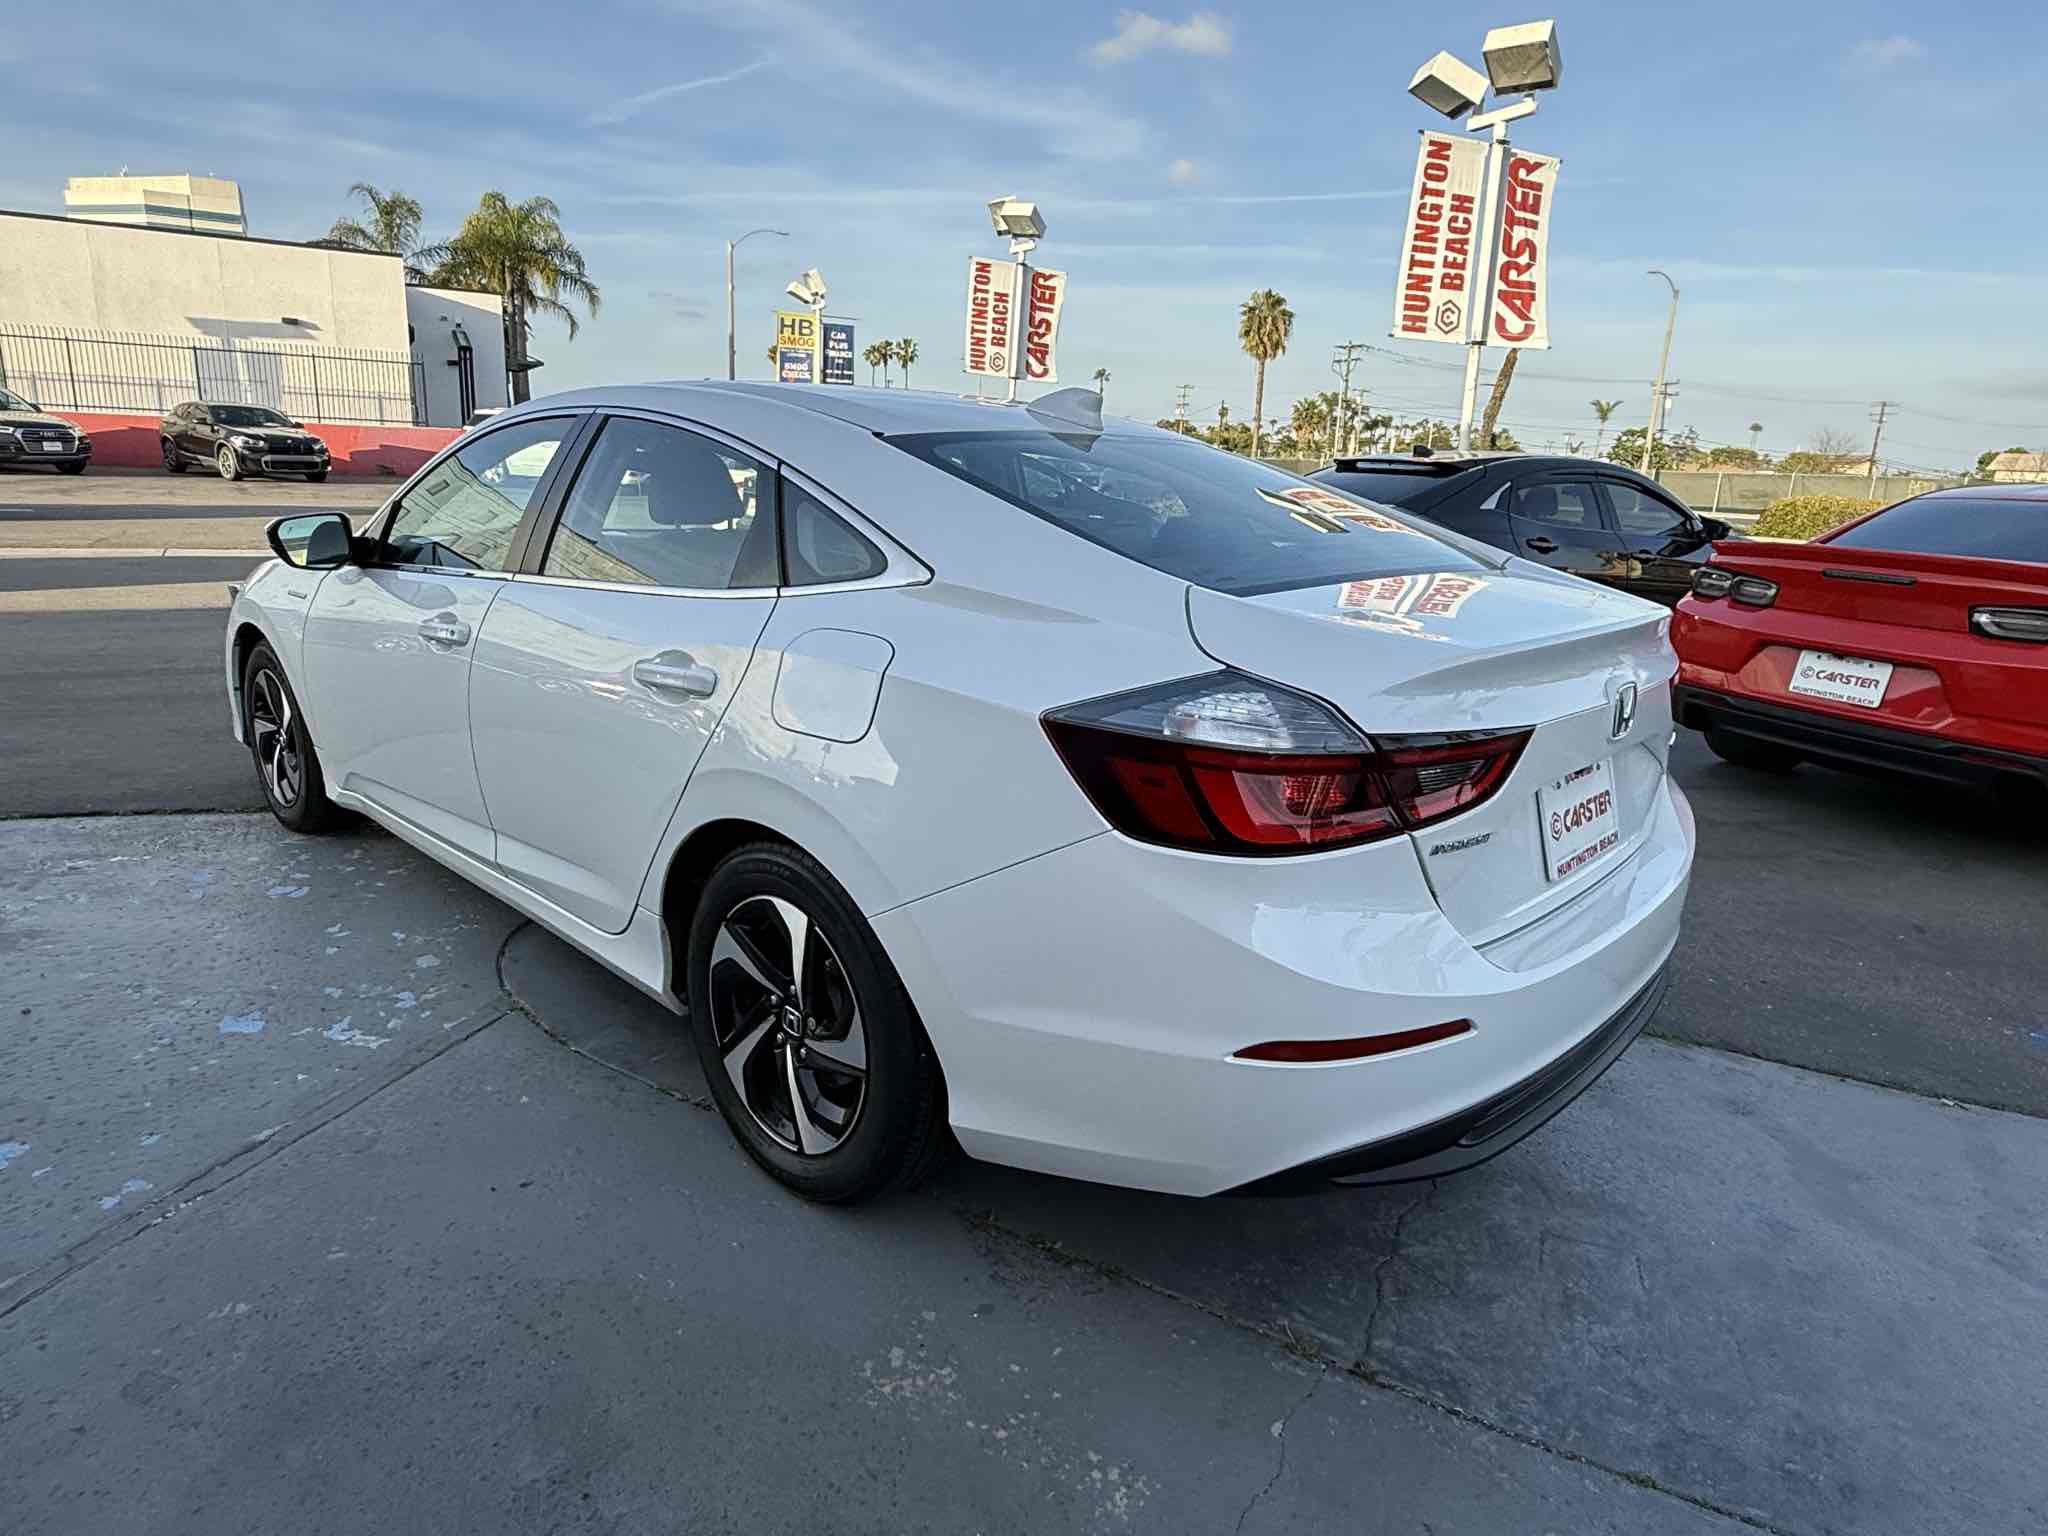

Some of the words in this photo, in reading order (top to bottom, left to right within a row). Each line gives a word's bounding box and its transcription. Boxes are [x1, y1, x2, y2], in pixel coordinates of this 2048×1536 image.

[1402, 139, 1453, 334] HUNTINGTON
[1440, 193, 1476, 292] BEACH
[1494, 156, 1548, 342] CARSTER
[780, 317, 814, 337] HB
[780, 335, 815, 348] SMOG
[969, 261, 992, 372] HUNTINGTON
[991, 291, 1010, 348] BEACH
[1025, 271, 1058, 379] CARSTER
[1792, 685, 1845, 700] HUNTINGTON
[1846, 695, 1874, 706] BEACH
[1816, 669, 1880, 690] CARSTER
[1563, 789, 1613, 833] CARSTER
[1556, 843, 1599, 878] HUNTINGTON
[1599, 830, 1619, 854] BEACH
